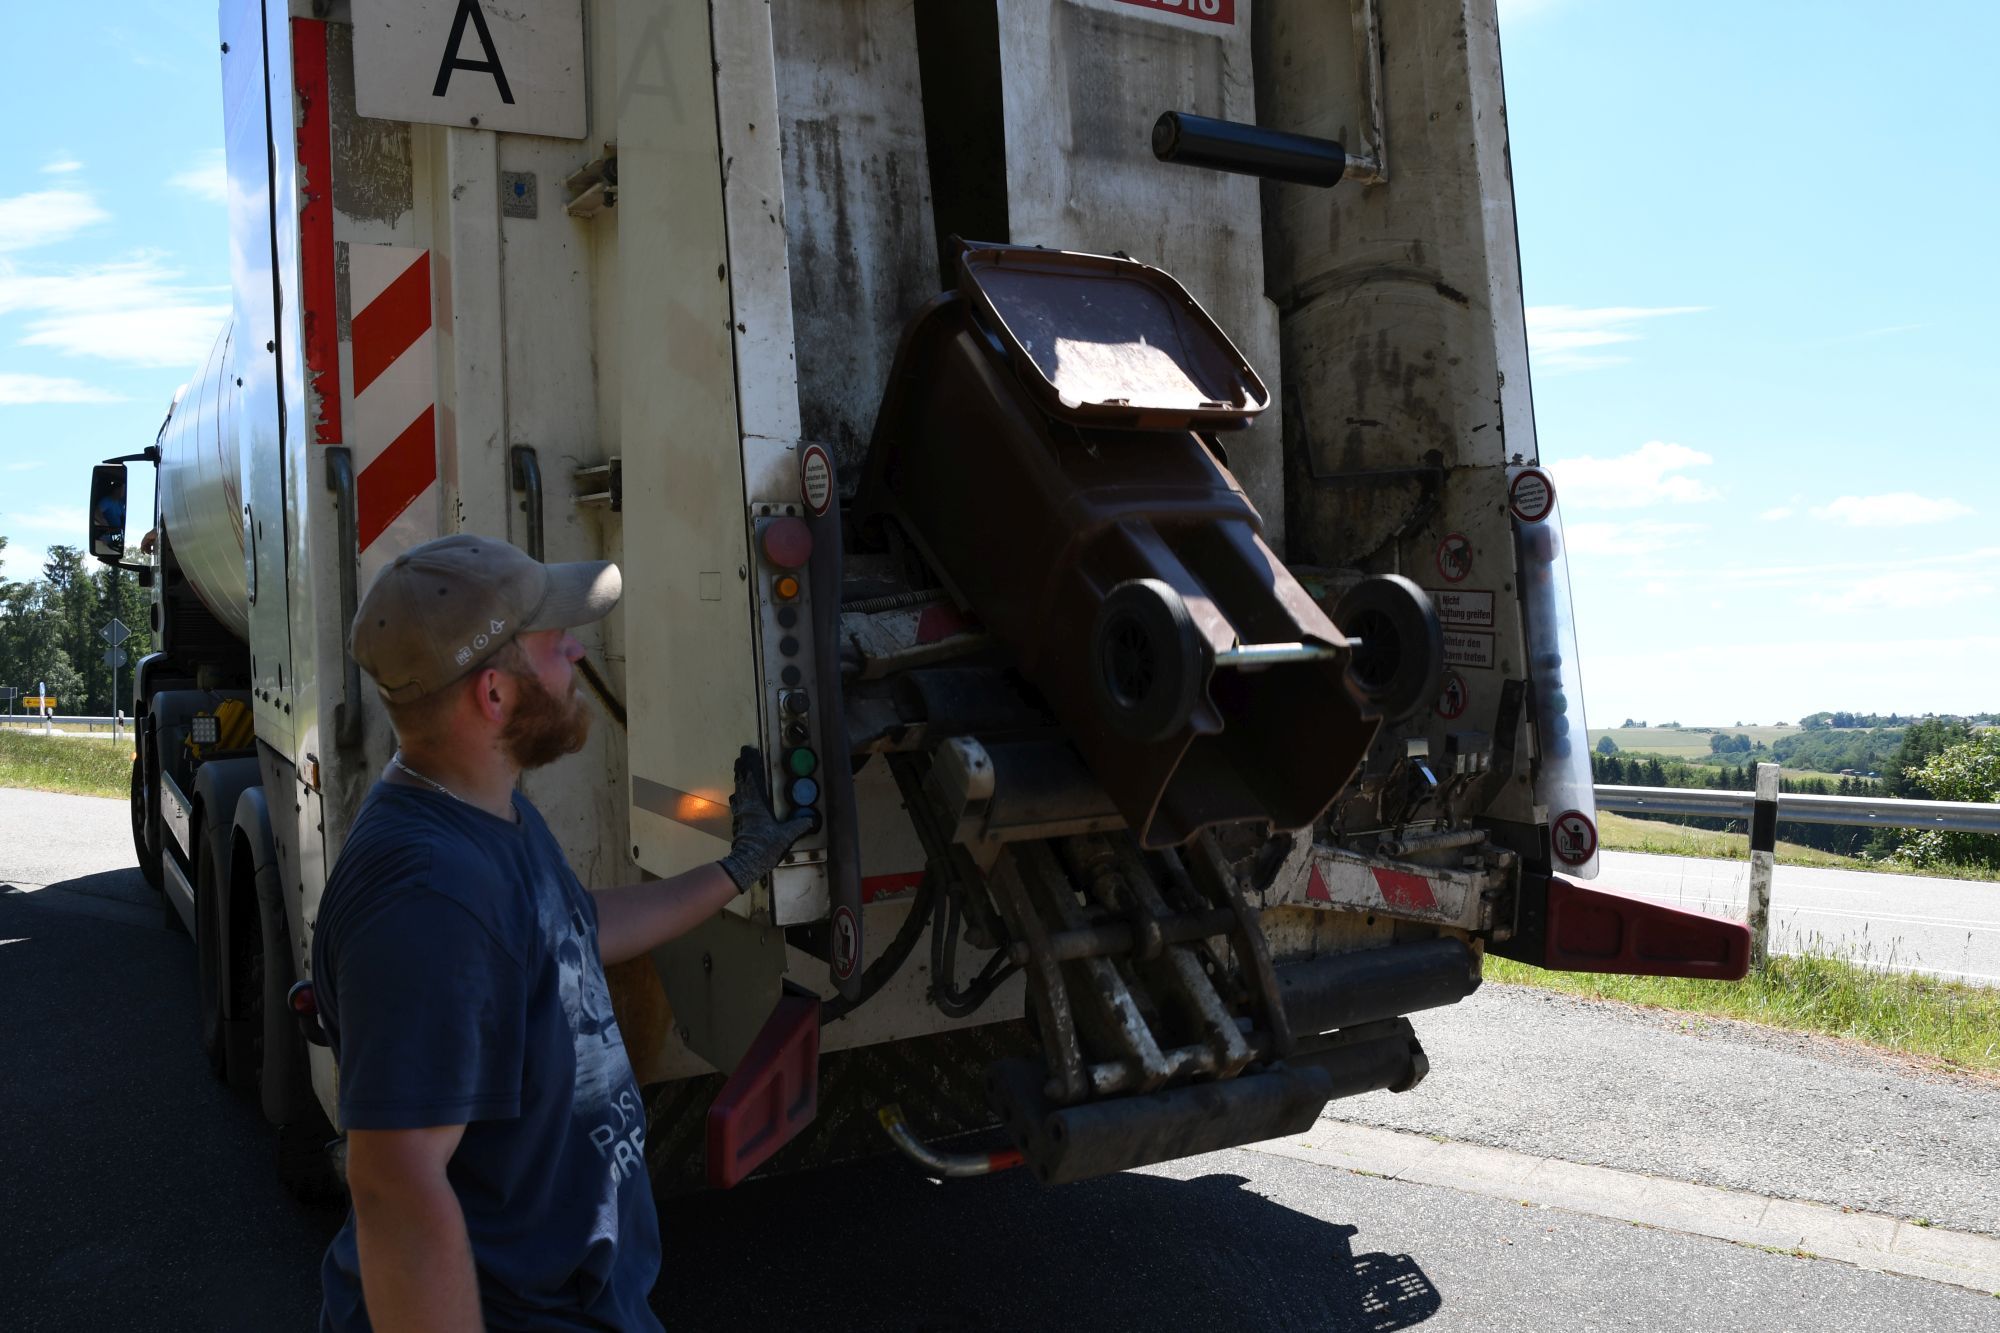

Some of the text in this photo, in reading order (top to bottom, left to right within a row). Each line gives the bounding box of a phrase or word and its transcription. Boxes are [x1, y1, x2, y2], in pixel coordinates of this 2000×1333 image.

[432, 0, 515, 104] A
[1466, 609, 1490, 620] greifen
[1467, 637, 1481, 648] den
[1464, 651, 1486, 662] treten
